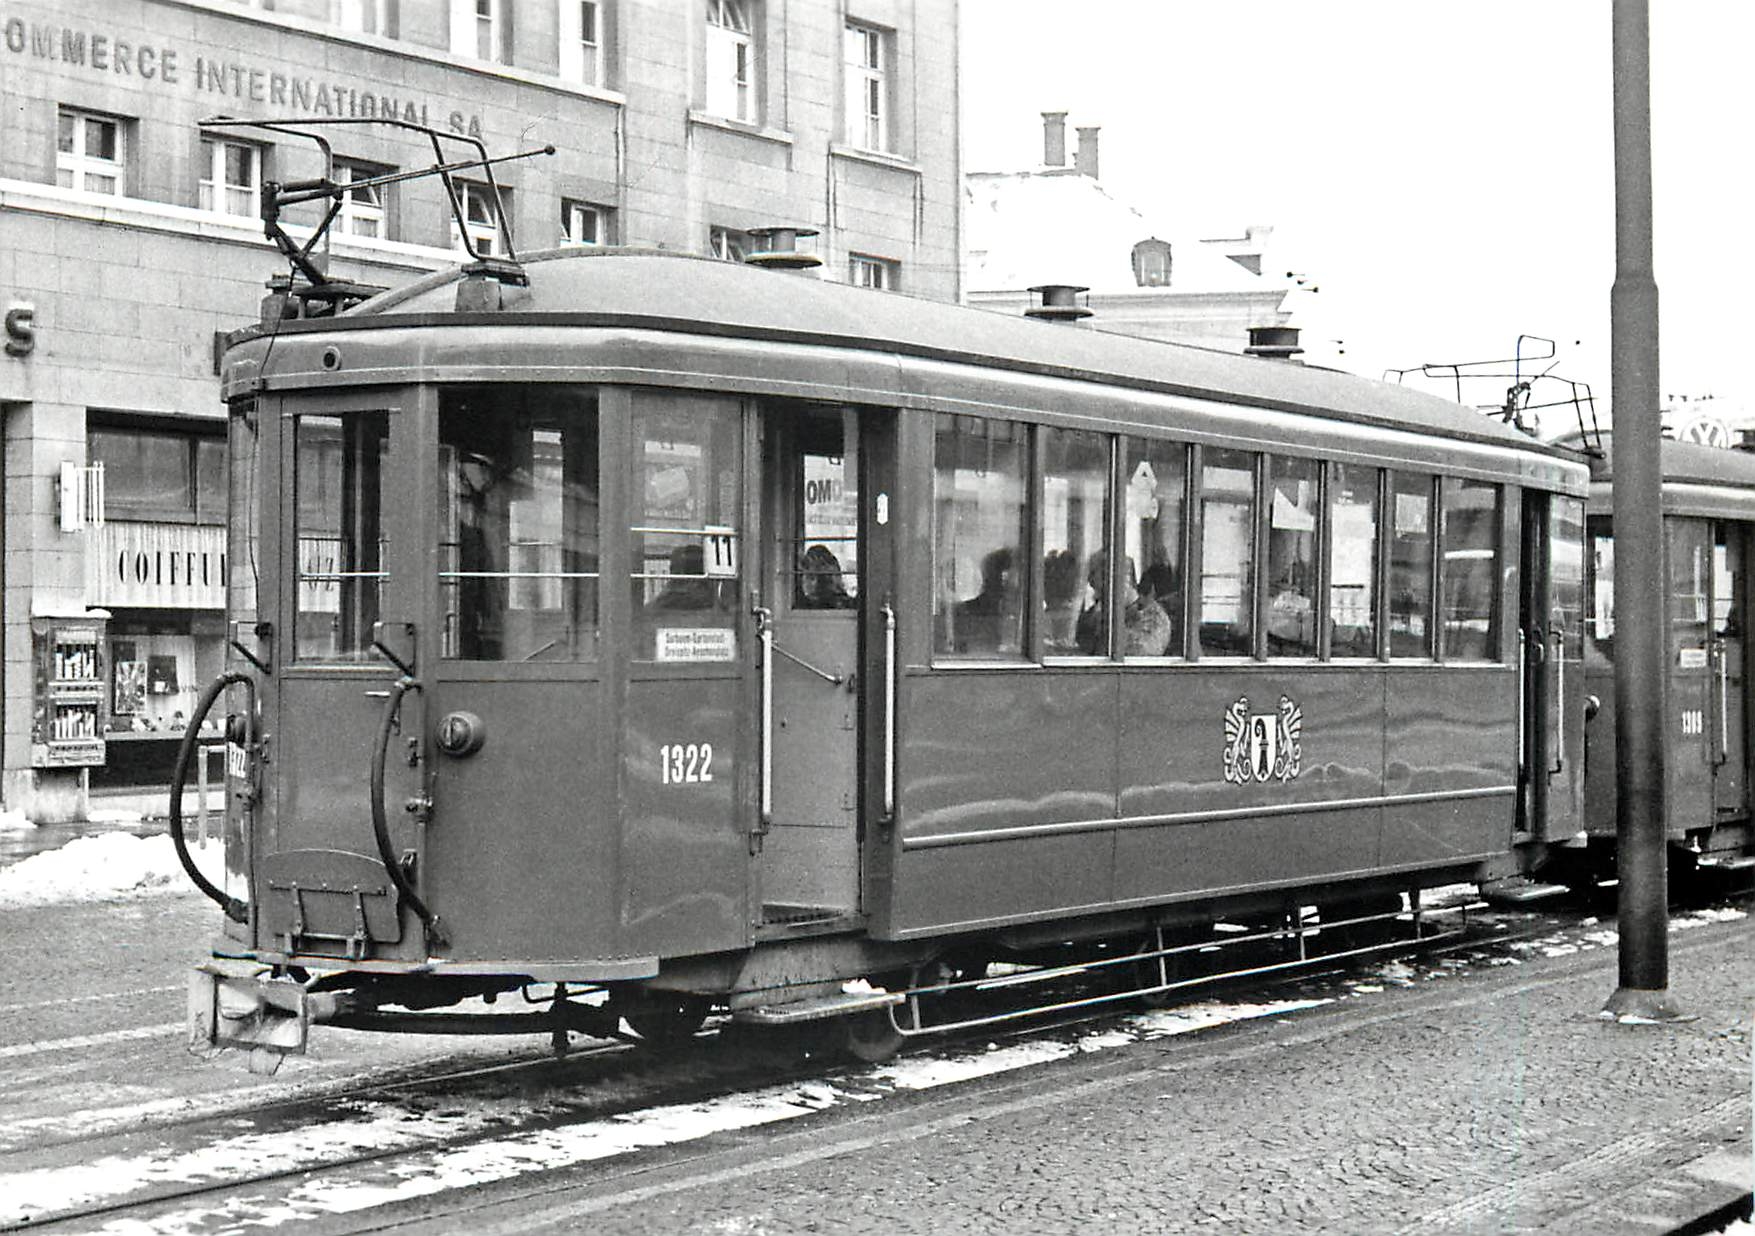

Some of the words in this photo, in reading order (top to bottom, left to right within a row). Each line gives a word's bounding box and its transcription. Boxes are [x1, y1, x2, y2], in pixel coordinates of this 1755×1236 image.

[5, 308, 35, 358] S
[711, 535, 732, 566] 11
[660, 743, 713, 784] 1322
